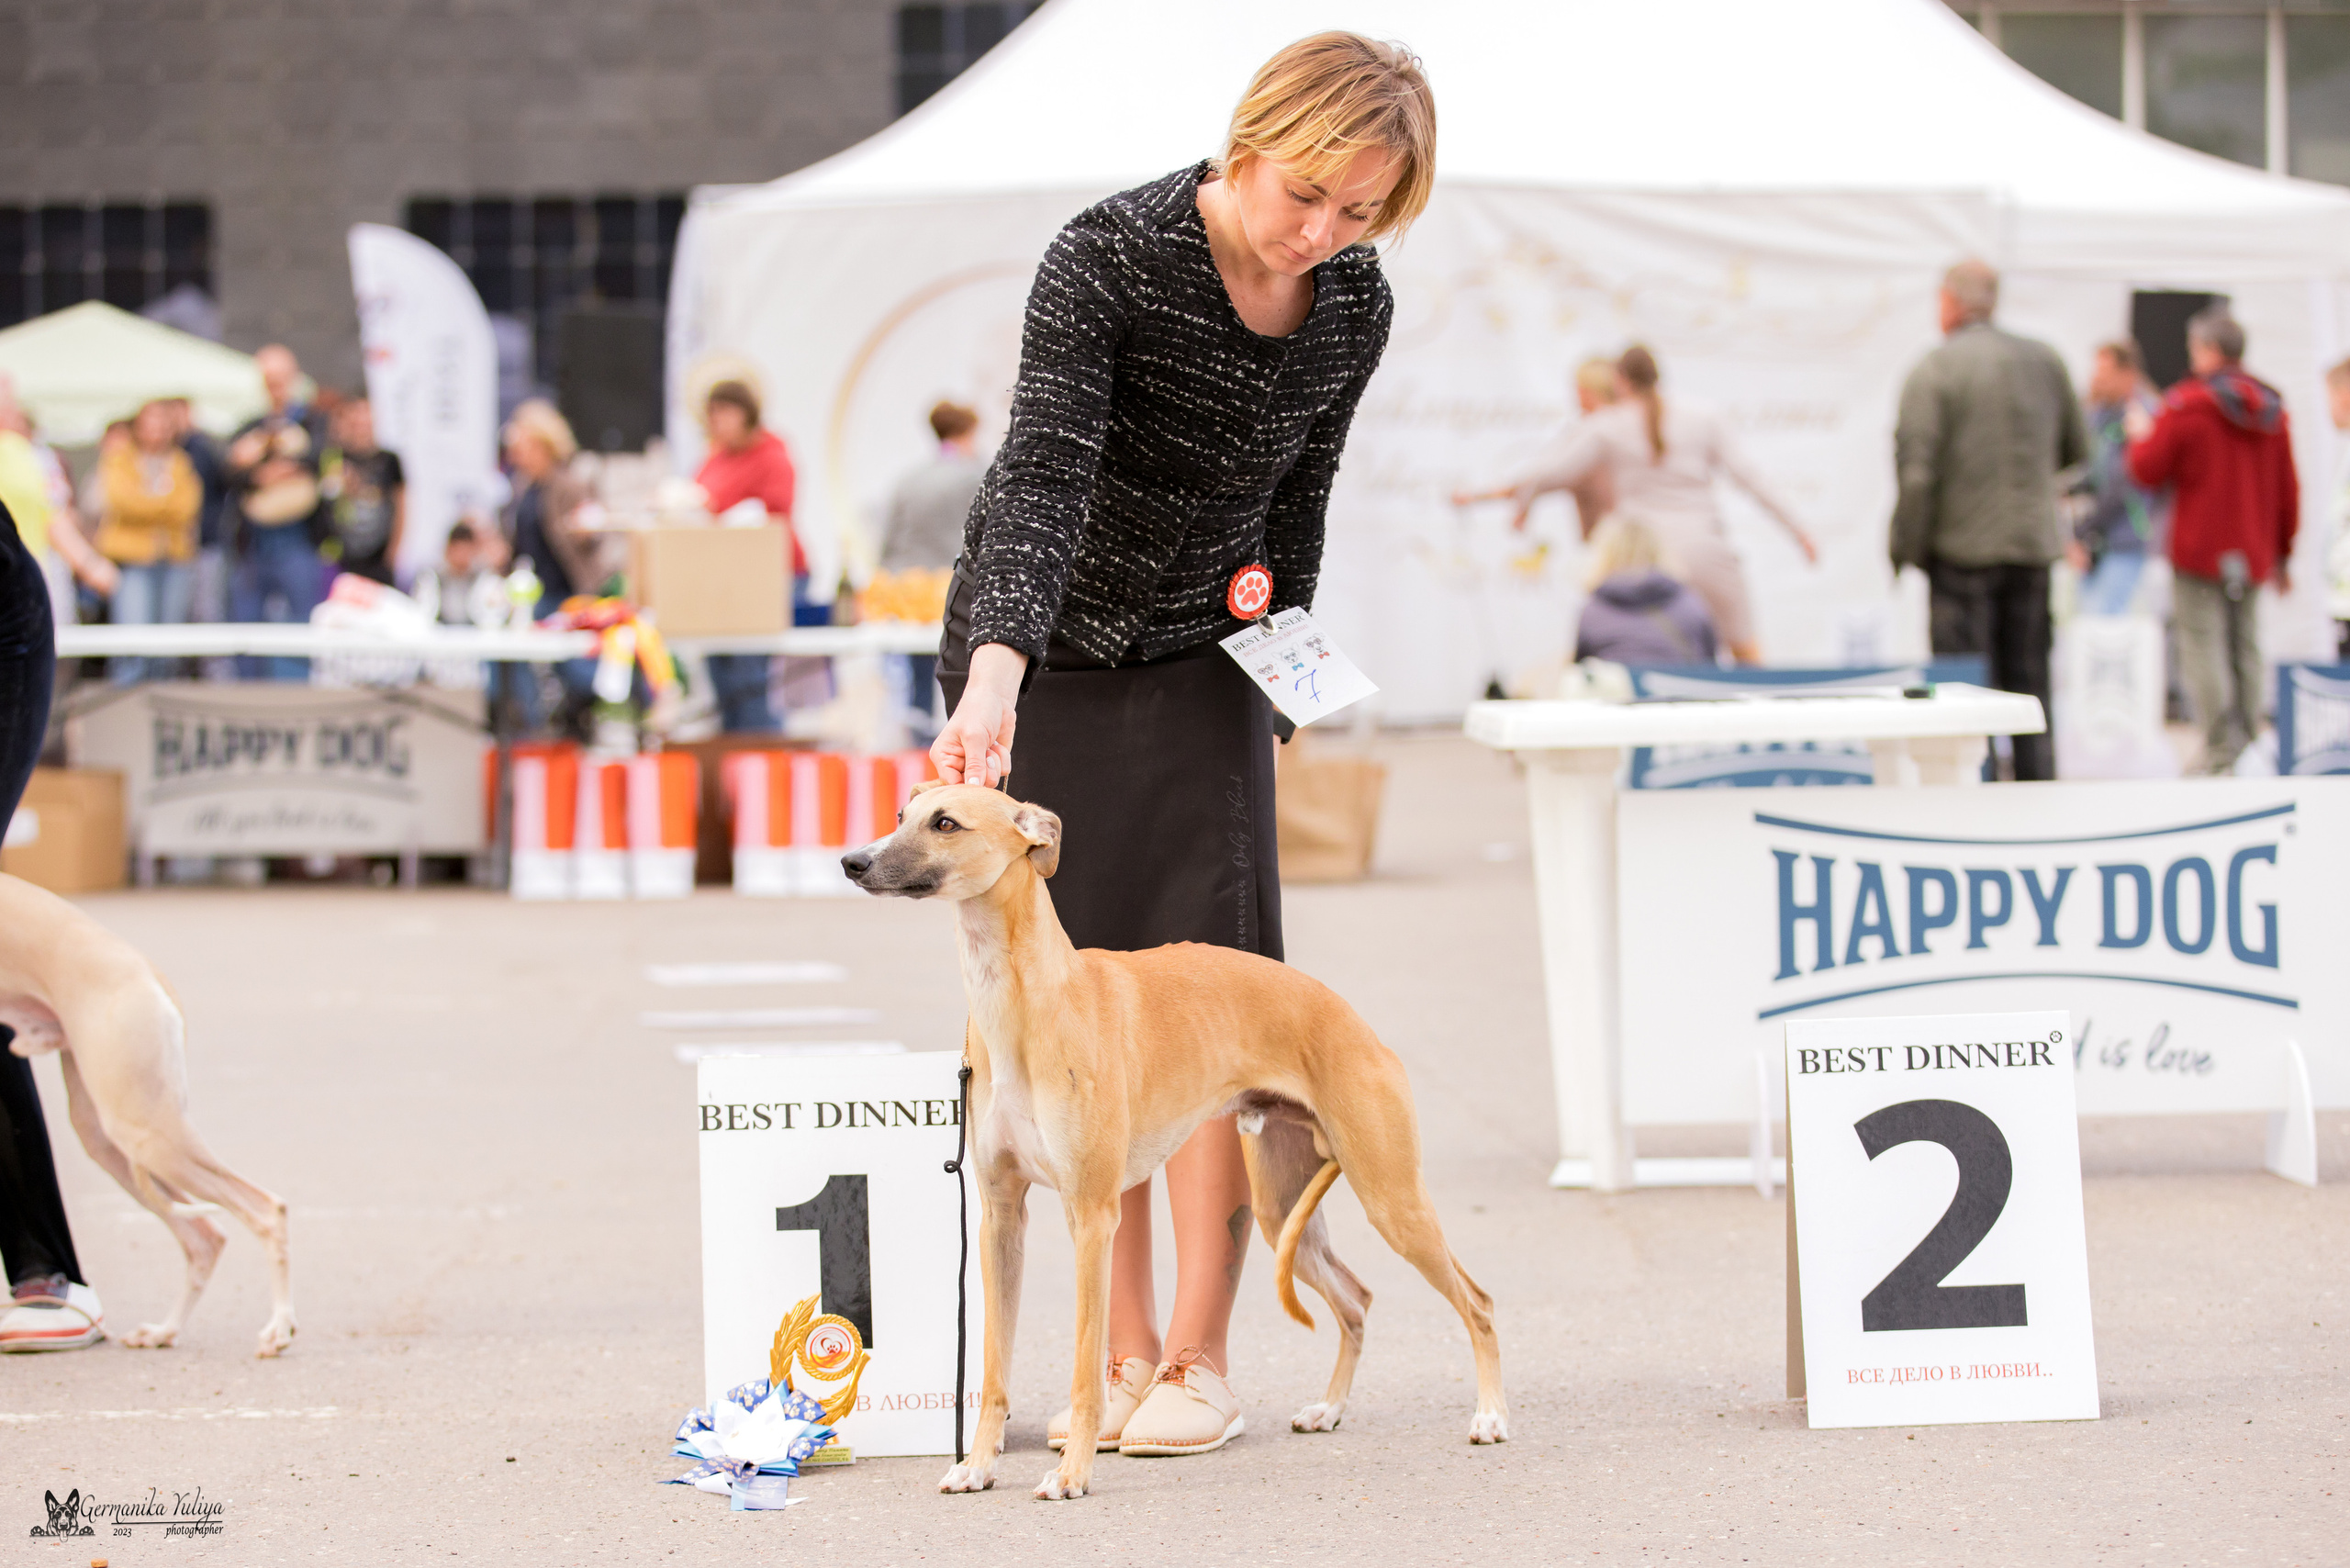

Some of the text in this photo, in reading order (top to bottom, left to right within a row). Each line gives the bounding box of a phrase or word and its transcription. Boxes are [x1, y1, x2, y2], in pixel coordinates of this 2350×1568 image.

[1231, 613, 1305, 653] BEST DNNER
[1294, 668, 1321, 703] 7
[1772, 844, 2279, 982] HAPPY DOG
[1796, 1046, 1893, 1075] BEST
[1903, 1039, 2055, 1070] DINNER
[2145, 1021, 2215, 1076] love
[699, 1103, 801, 1132] BEST
[1853, 1099, 2028, 1332] 2
[776, 1174, 873, 1349] 1
[1846, 1368, 1885, 1383] ВСЕ
[1889, 1365, 1943, 1385] ДЕЛО
[1949, 1365, 1962, 1380] В
[856, 1395, 871, 1412] В
